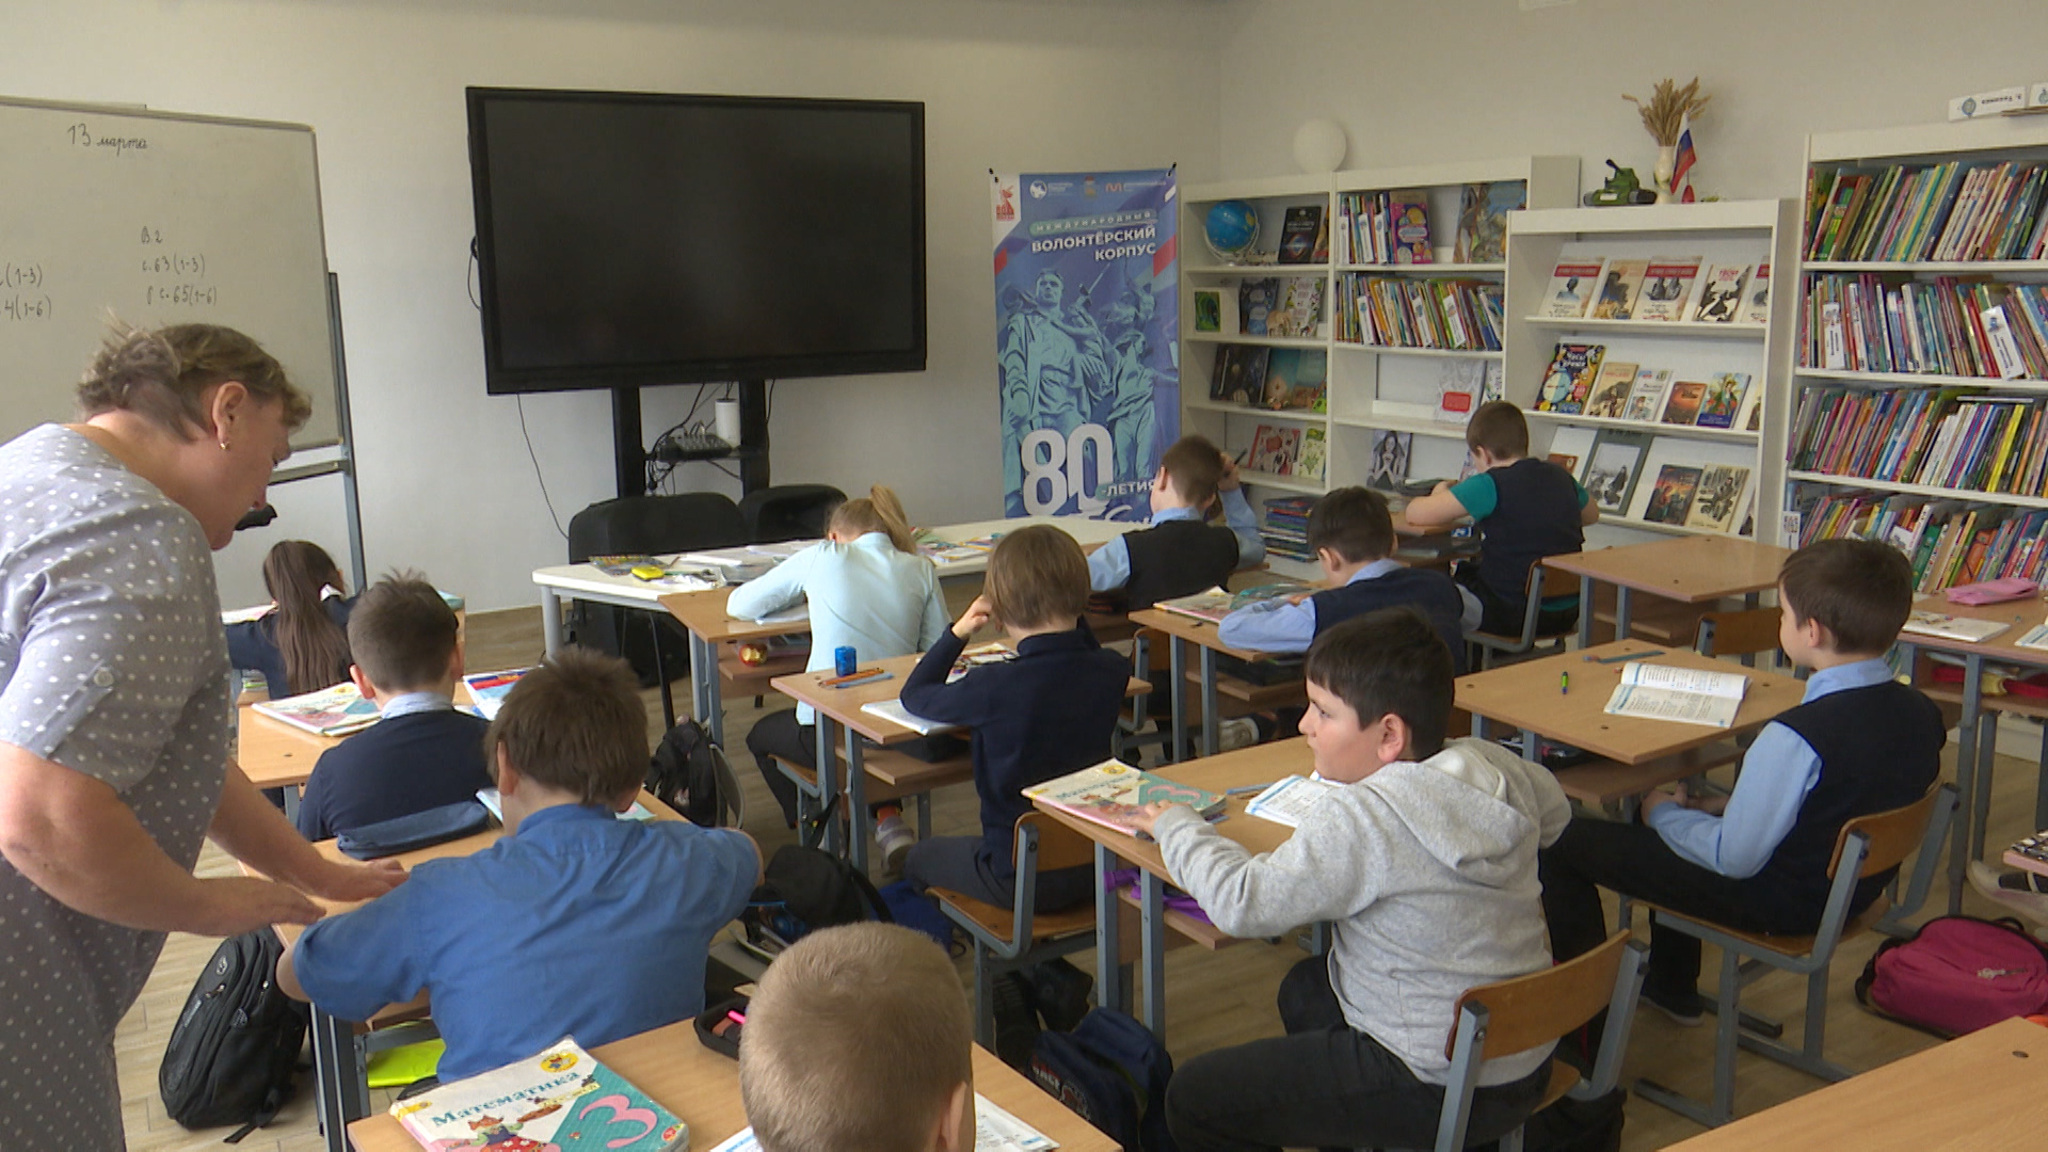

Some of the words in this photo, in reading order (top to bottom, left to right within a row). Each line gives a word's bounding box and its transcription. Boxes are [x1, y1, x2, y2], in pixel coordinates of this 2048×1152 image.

[67, 123, 91, 147] 13
[97, 137, 147, 157] марта
[1036, 209, 1152, 232] МЕЖДУНАРОДНЫЙ
[1031, 224, 1156, 254] ВОЛОНТЁРСКИЙ
[1094, 243, 1157, 262] КОРПУС
[1021, 423, 1114, 516] 80
[431, 1071, 581, 1127] Математика
[578, 1094, 658, 1149] 3
